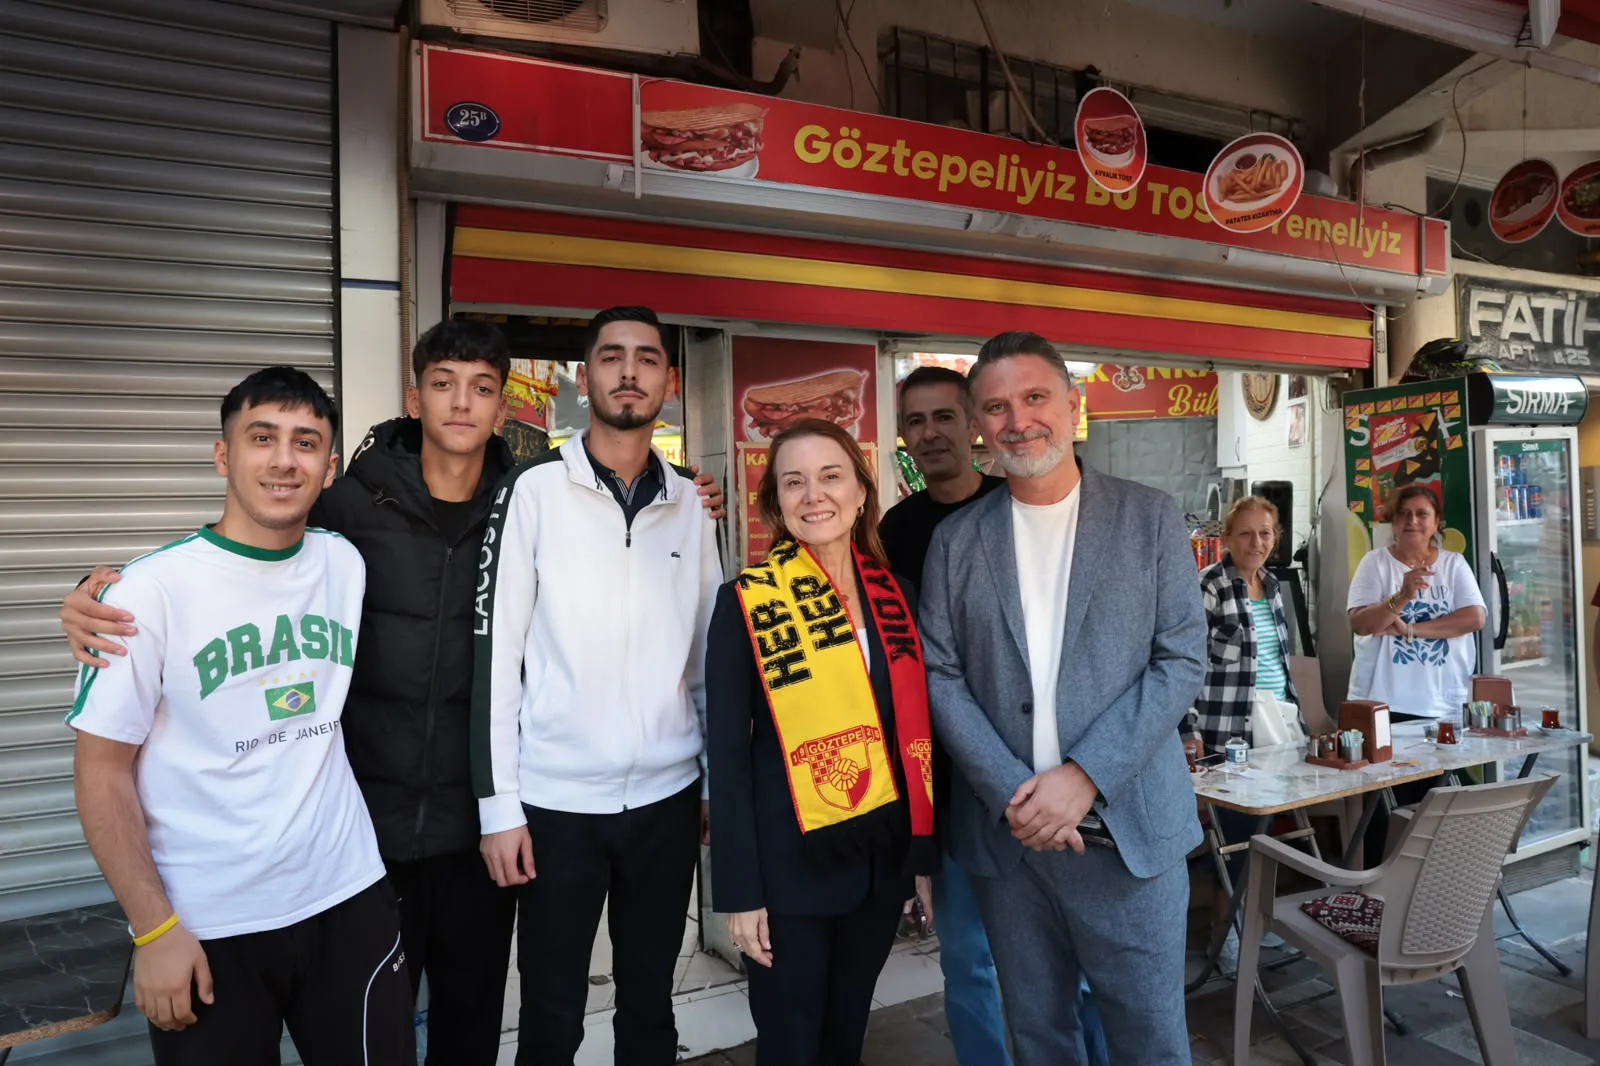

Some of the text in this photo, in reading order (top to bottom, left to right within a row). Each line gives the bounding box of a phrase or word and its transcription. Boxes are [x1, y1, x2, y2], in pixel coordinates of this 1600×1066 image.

[793, 124, 1077, 206] Göztepeliyiz
[1147, 182, 1214, 223] TOS
[1167, 383, 1218, 416] Büf
[790, 573, 857, 652] HER
[750, 598, 813, 692] HER
[235, 720, 341, 753] RIO DE JANEIR
[808, 729, 863, 754] GÖZTEPE
